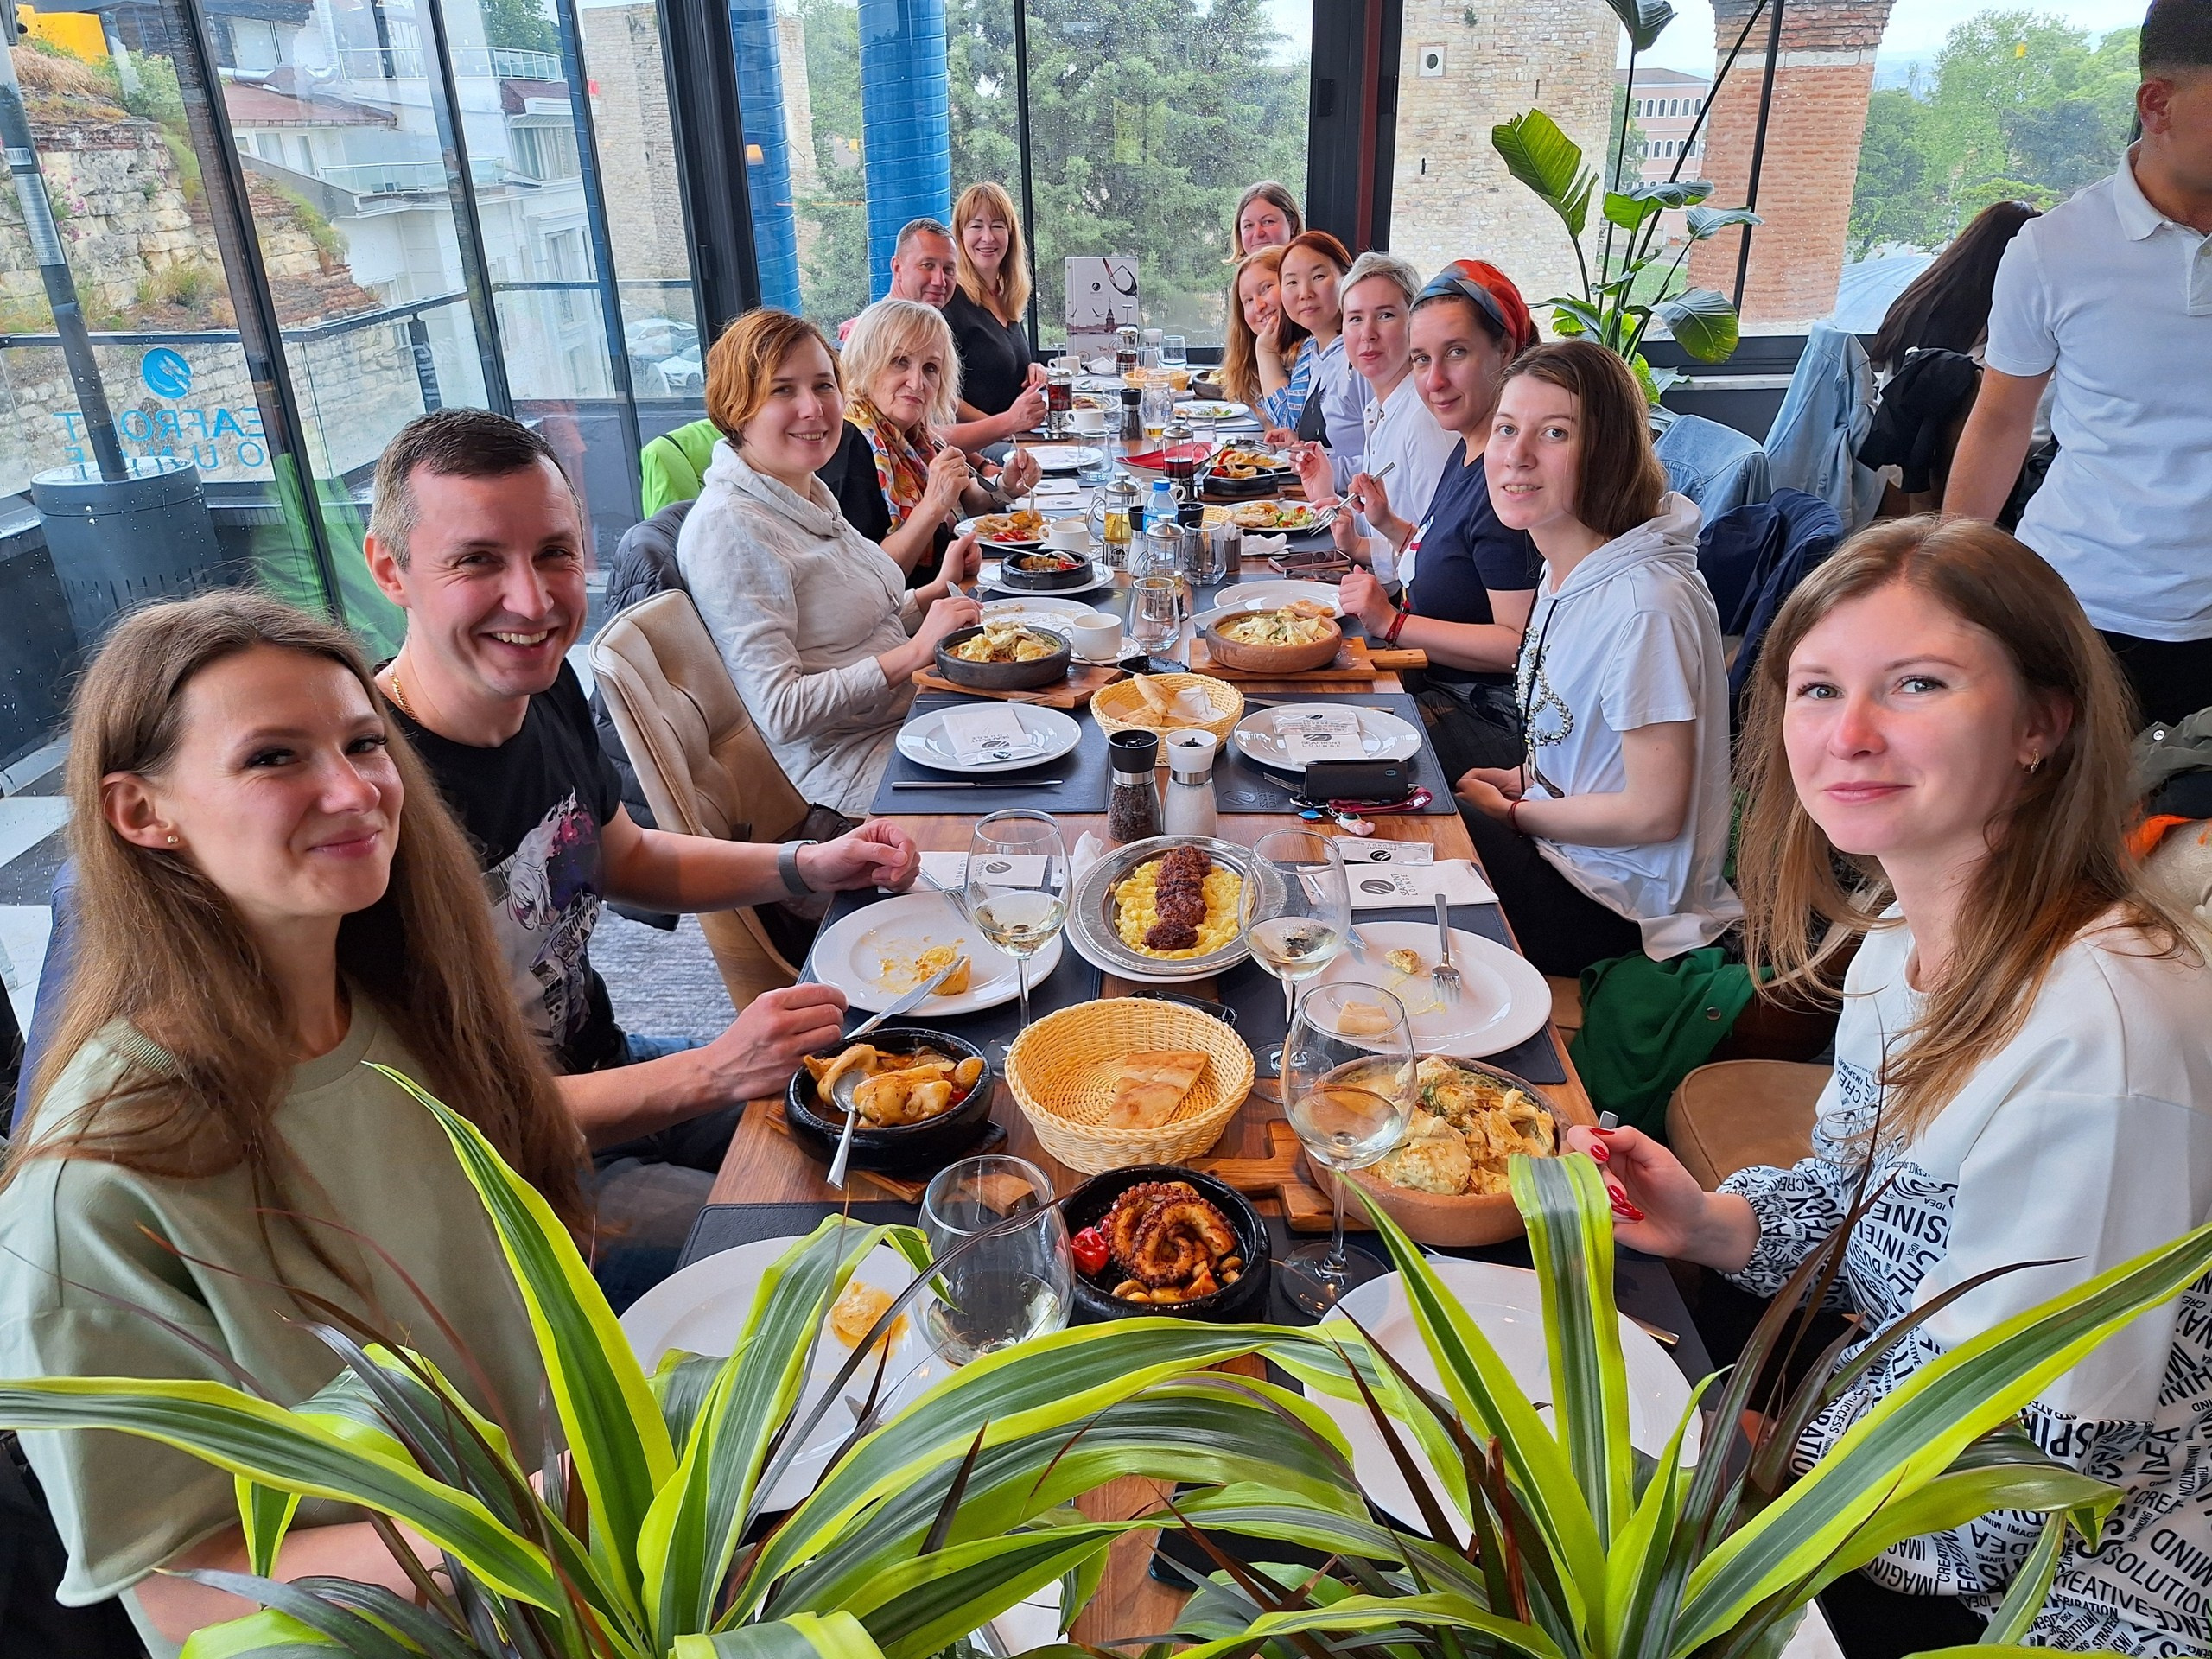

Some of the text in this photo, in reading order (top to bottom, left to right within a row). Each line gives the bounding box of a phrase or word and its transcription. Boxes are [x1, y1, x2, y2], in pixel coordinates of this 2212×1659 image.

[1924, 1198, 1946, 1211] IDEA
[1872, 1200, 1948, 1244] SINE
[2054, 1570, 2149, 1617] REATIVE
[2061, 1611, 2074, 1624] IDEA
